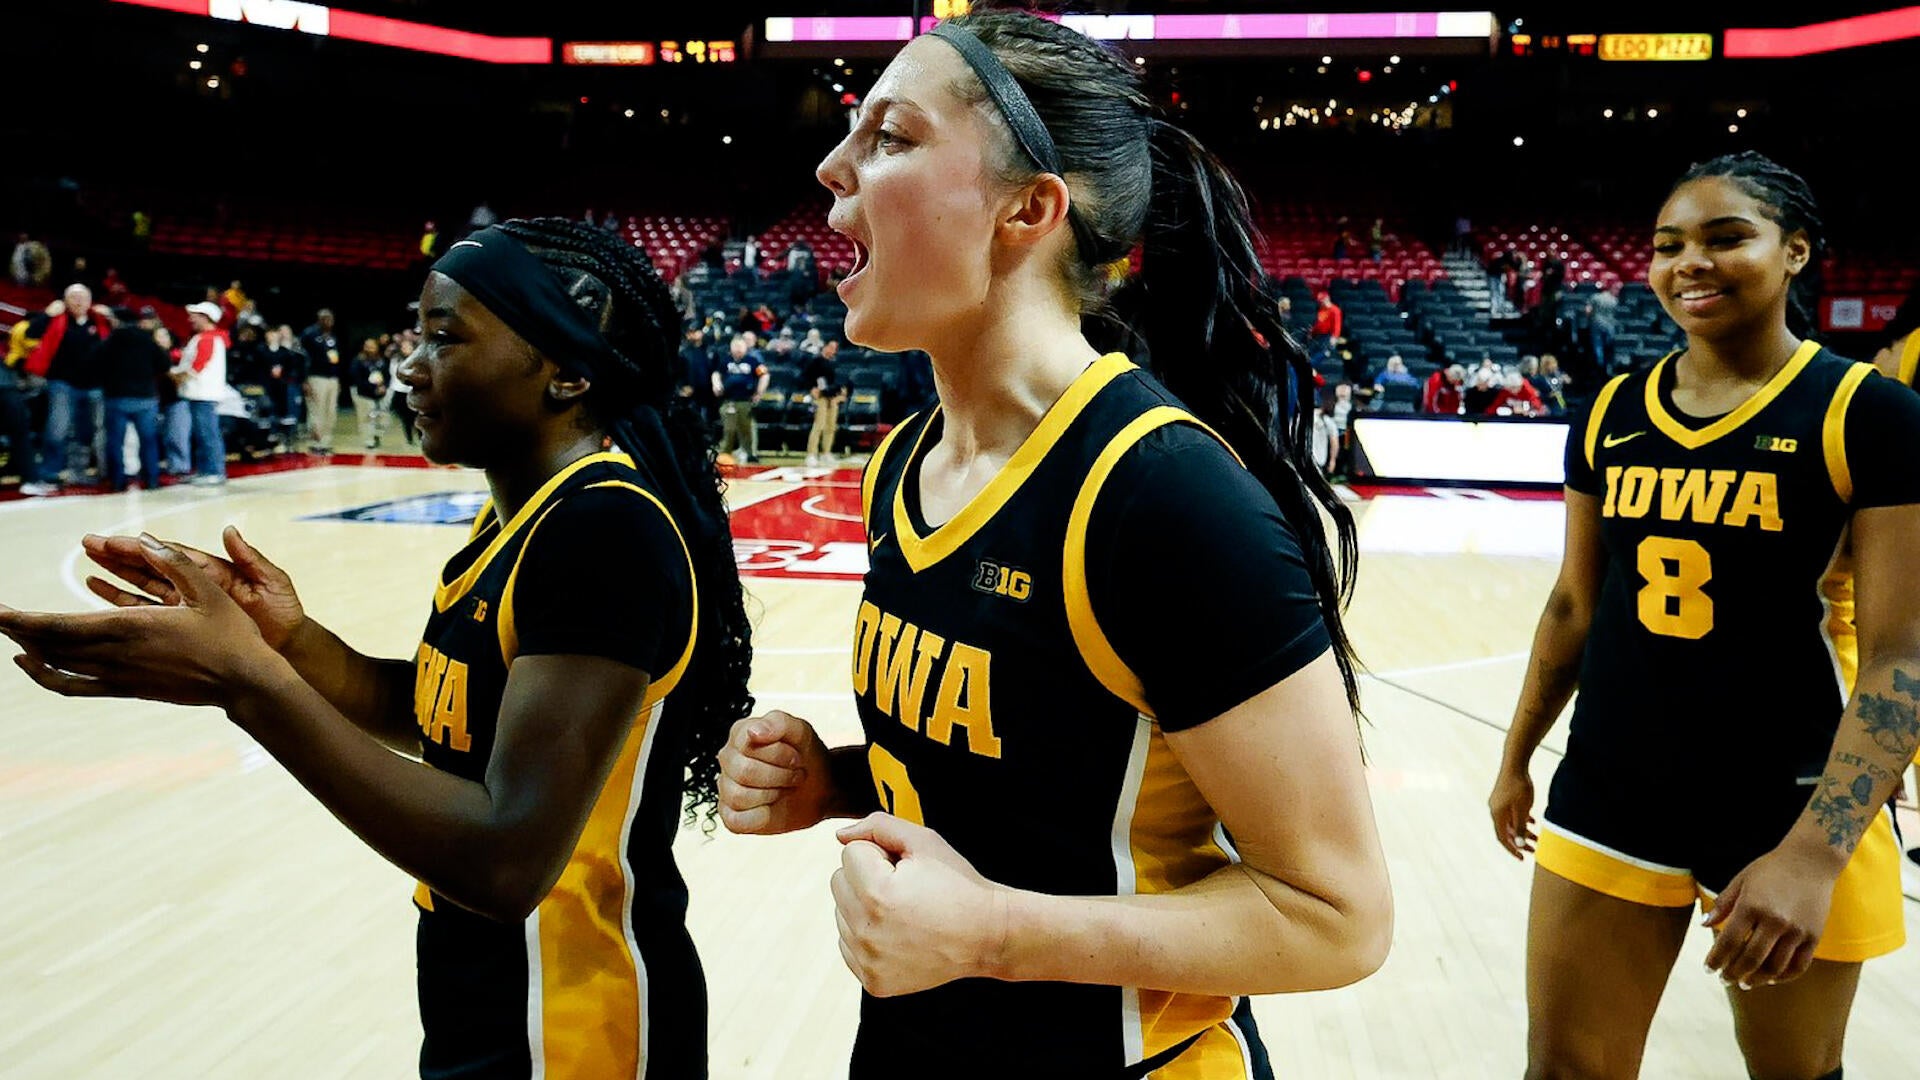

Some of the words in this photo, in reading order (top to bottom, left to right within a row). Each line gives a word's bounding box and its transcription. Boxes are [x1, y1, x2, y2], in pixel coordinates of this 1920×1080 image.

[1656, 38, 1708, 55] PIZZA
[1602, 466, 1784, 531] IOWA
[1637, 535, 1714, 640] 8
[414, 642, 472, 753] WA
[853, 600, 1002, 759] OWA
